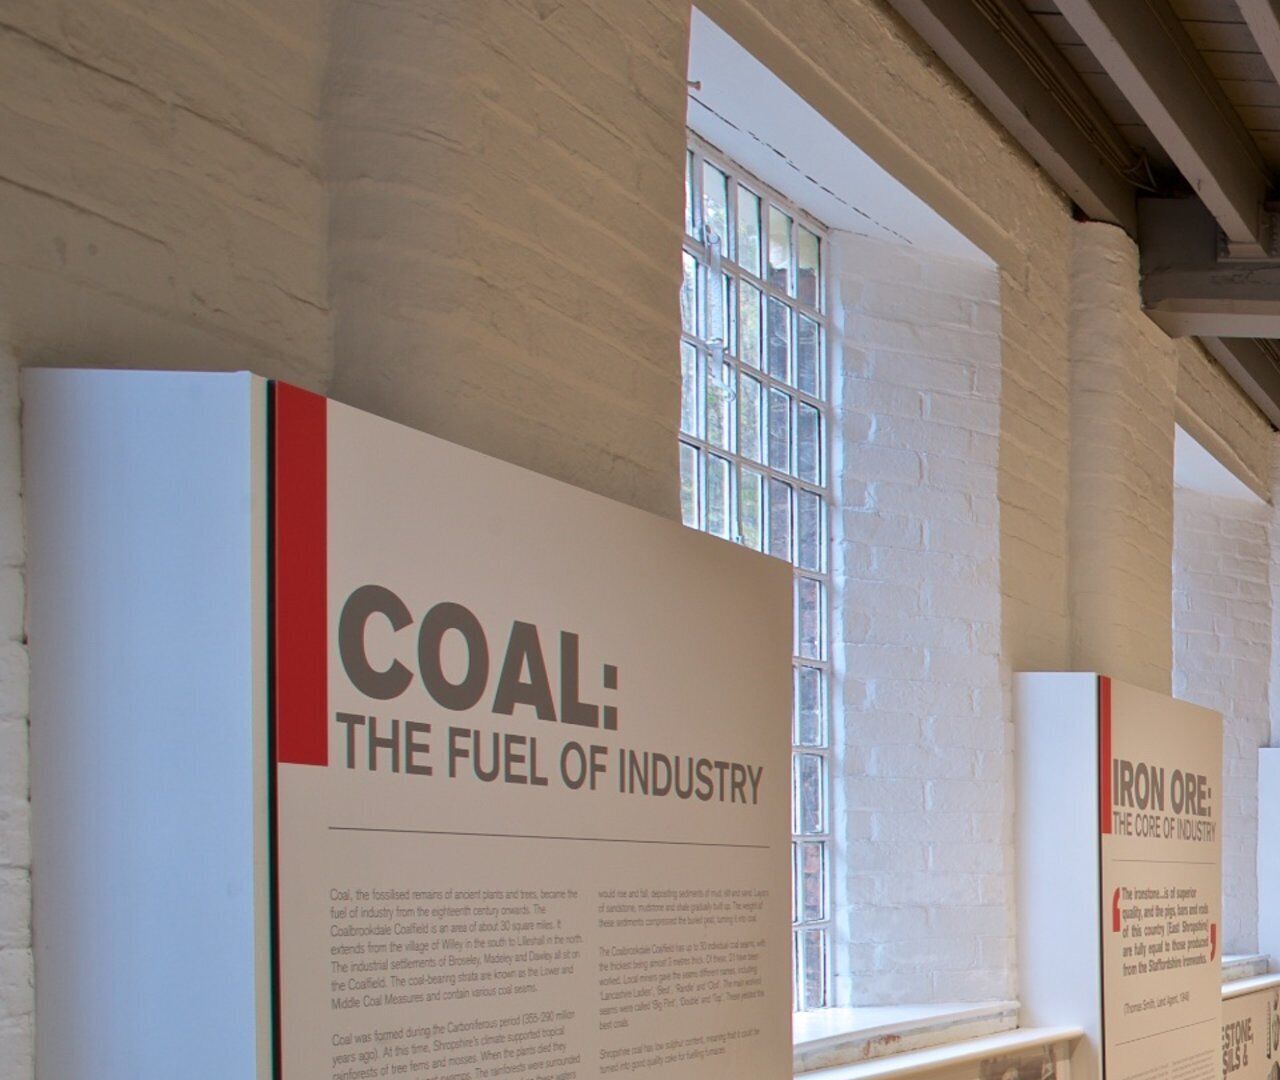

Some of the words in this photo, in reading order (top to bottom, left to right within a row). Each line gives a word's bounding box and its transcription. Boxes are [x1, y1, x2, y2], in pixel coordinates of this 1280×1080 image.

[338, 584, 618, 731] COAL:
[336, 712, 432, 776] THE
[448, 726, 548, 787] FUEL
[561, 741, 609, 791] OF
[619, 749, 764, 805] INDUSTRY
[1113, 759, 1165, 811] IRON
[1170, 769, 1211, 817] ORE:
[1113, 811, 1132, 836] THE
[1135, 814, 1161, 838] CORE
[1163, 817, 1175, 839] OF
[1177, 819, 1216, 842] INDUSTRY
[1222, 1046, 1241, 1075] SILS
